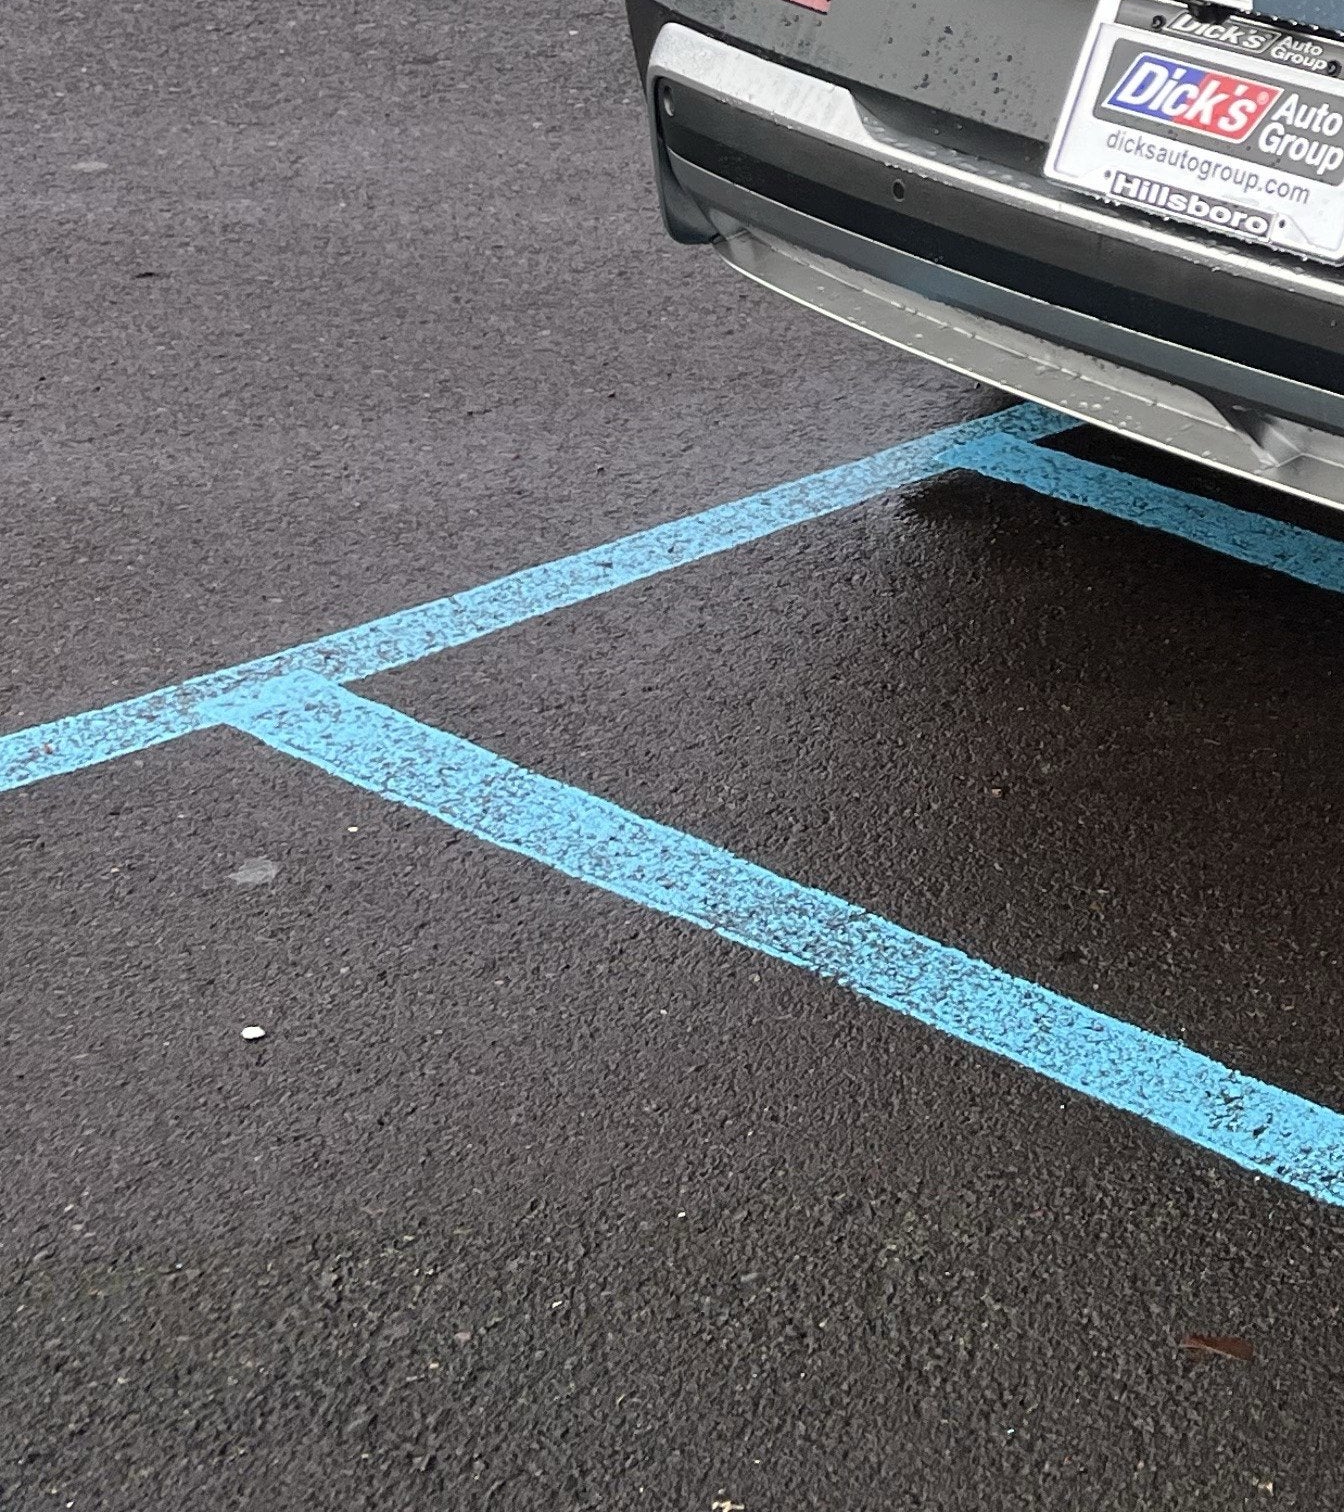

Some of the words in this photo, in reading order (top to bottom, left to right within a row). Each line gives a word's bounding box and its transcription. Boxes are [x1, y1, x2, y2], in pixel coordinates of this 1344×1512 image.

[1171, 12, 1268, 50] Dick's
[1279, 35, 1324, 57] Auto
[1269, 45, 1330, 72] Group
[1116, 63, 1259, 133] Dick's
[1272, 93, 1344, 137] Auto
[1107, 130, 1310, 205] dicksautogroup.com
[1258, 127, 1344, 175] Group
[1111, 171, 1270, 235] Hillsboro
